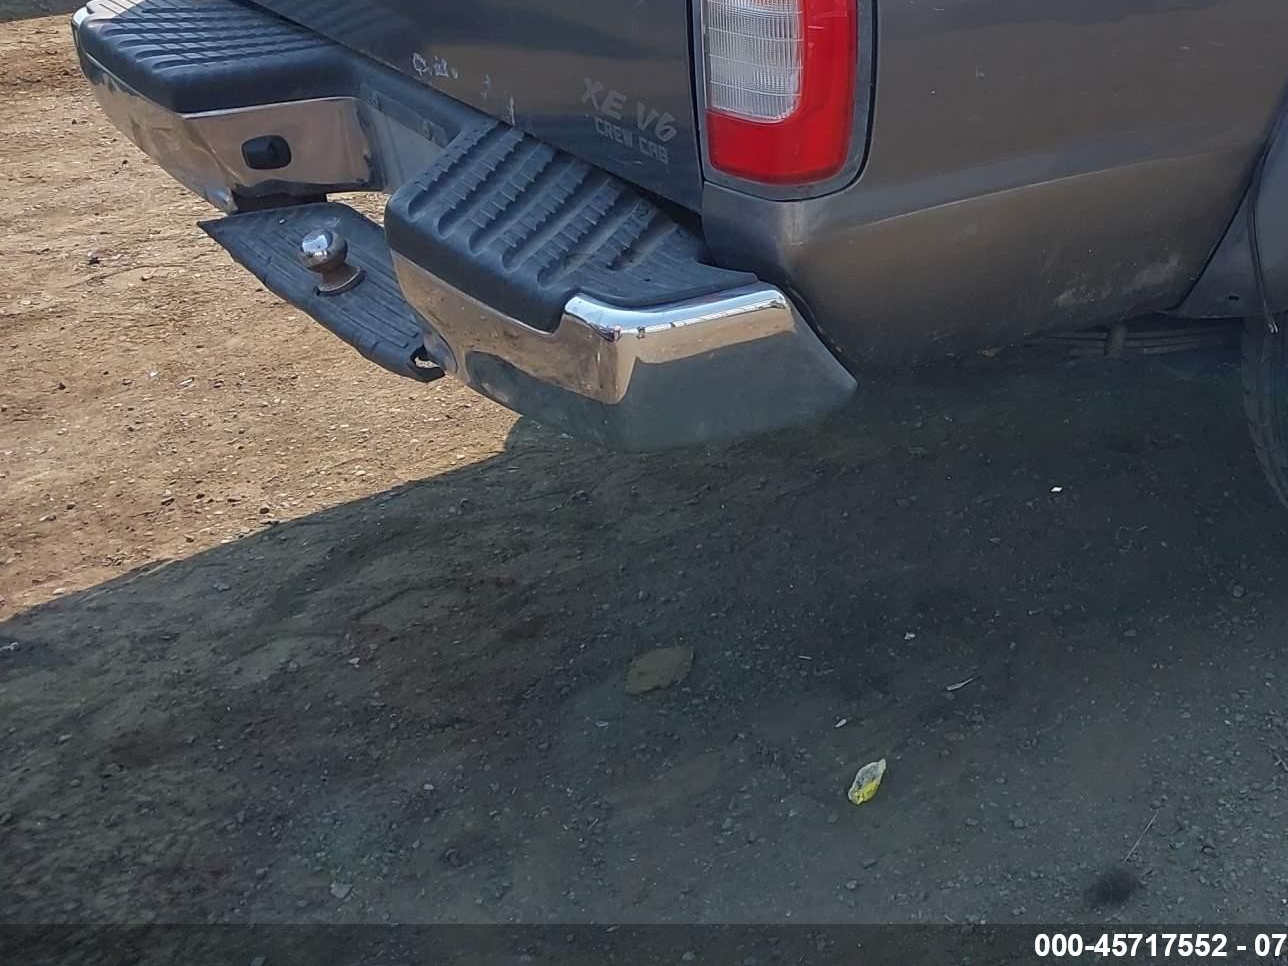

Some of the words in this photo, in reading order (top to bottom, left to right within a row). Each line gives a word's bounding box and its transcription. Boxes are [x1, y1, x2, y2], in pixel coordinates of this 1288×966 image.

[582, 77, 627, 120] XE
[637, 101, 677, 142] V6
[594, 116, 633, 148] CREW
[639, 136, 669, 165] CAB
